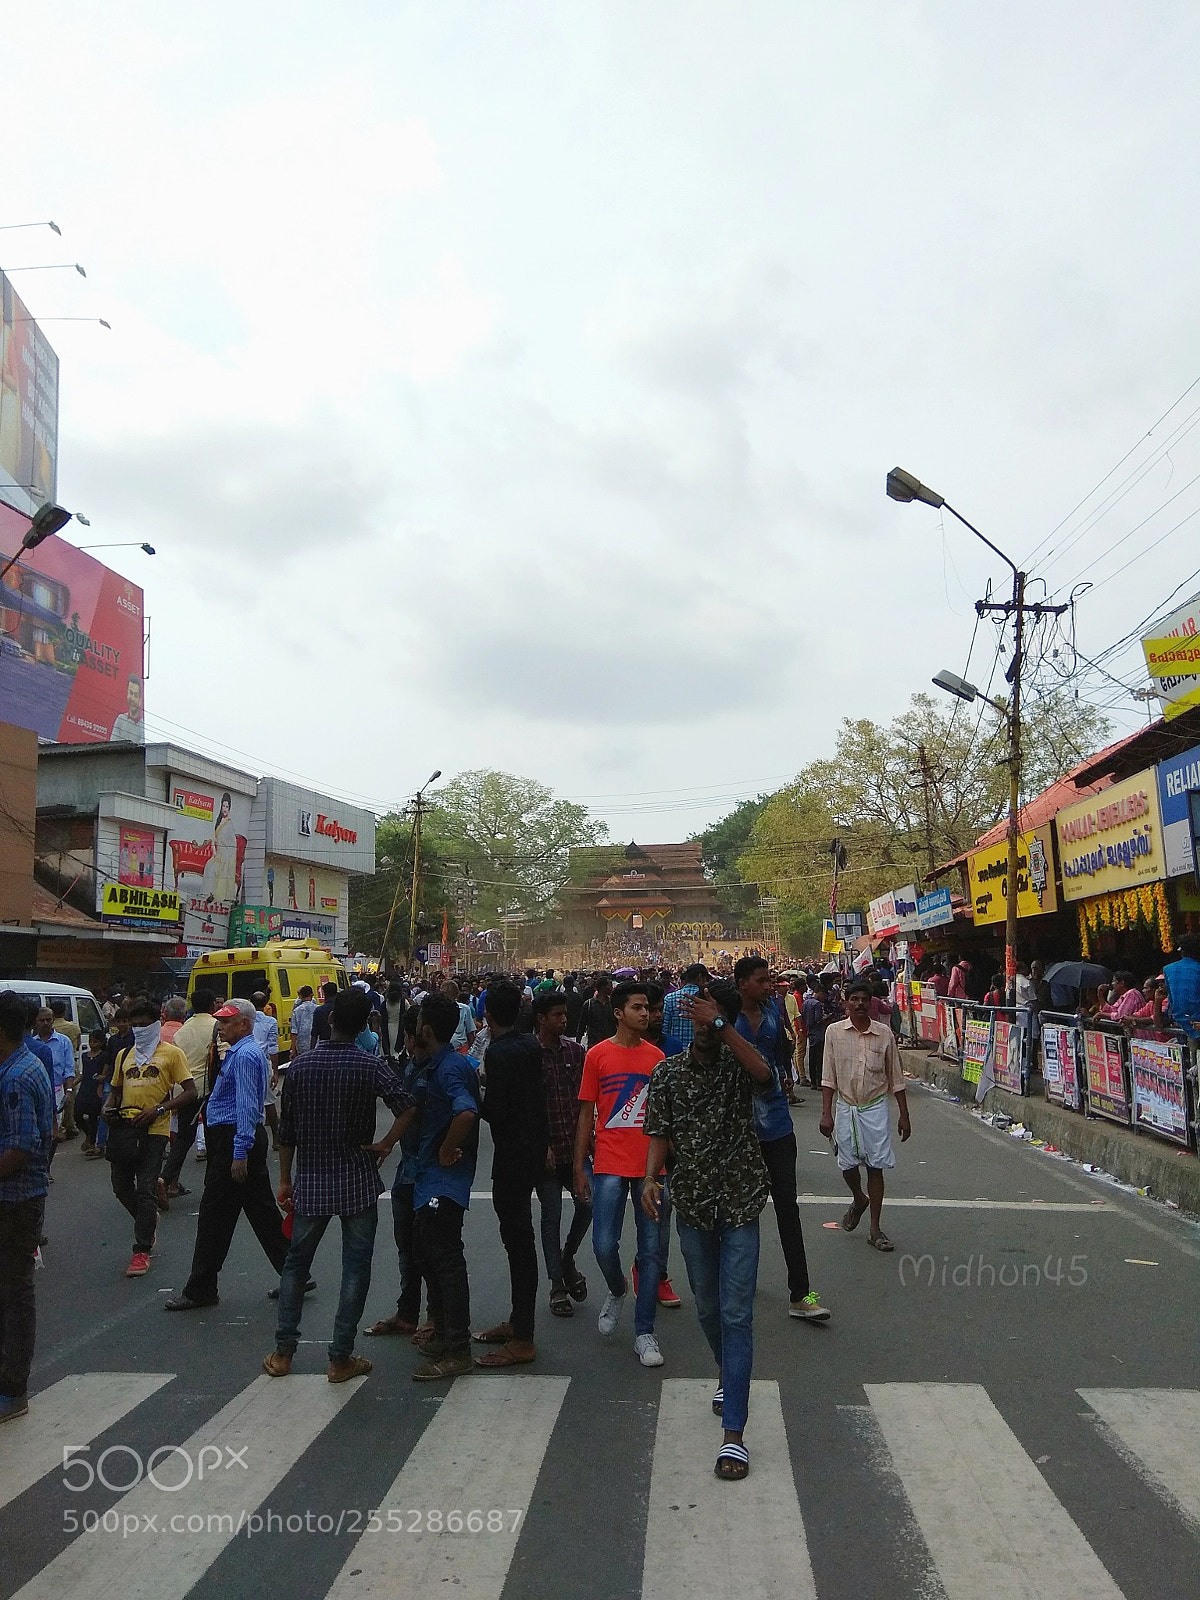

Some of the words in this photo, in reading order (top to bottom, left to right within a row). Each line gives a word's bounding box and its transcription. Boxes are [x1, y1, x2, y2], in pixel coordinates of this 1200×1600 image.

[117, 596, 140, 615] ASSET
[66, 629, 120, 664] QUALITY
[73, 649, 80, 664] is
[80, 653, 119, 680] ASSET
[189, 796, 212, 808] Kalyan
[1096, 790, 1148, 831] JEWELLERS
[315, 813, 357, 843] Kalyan
[108, 888, 177, 909] ABHILASH
[122, 906, 160, 916] JEWELLERY
[621, 1080, 644, 1120] adidas
